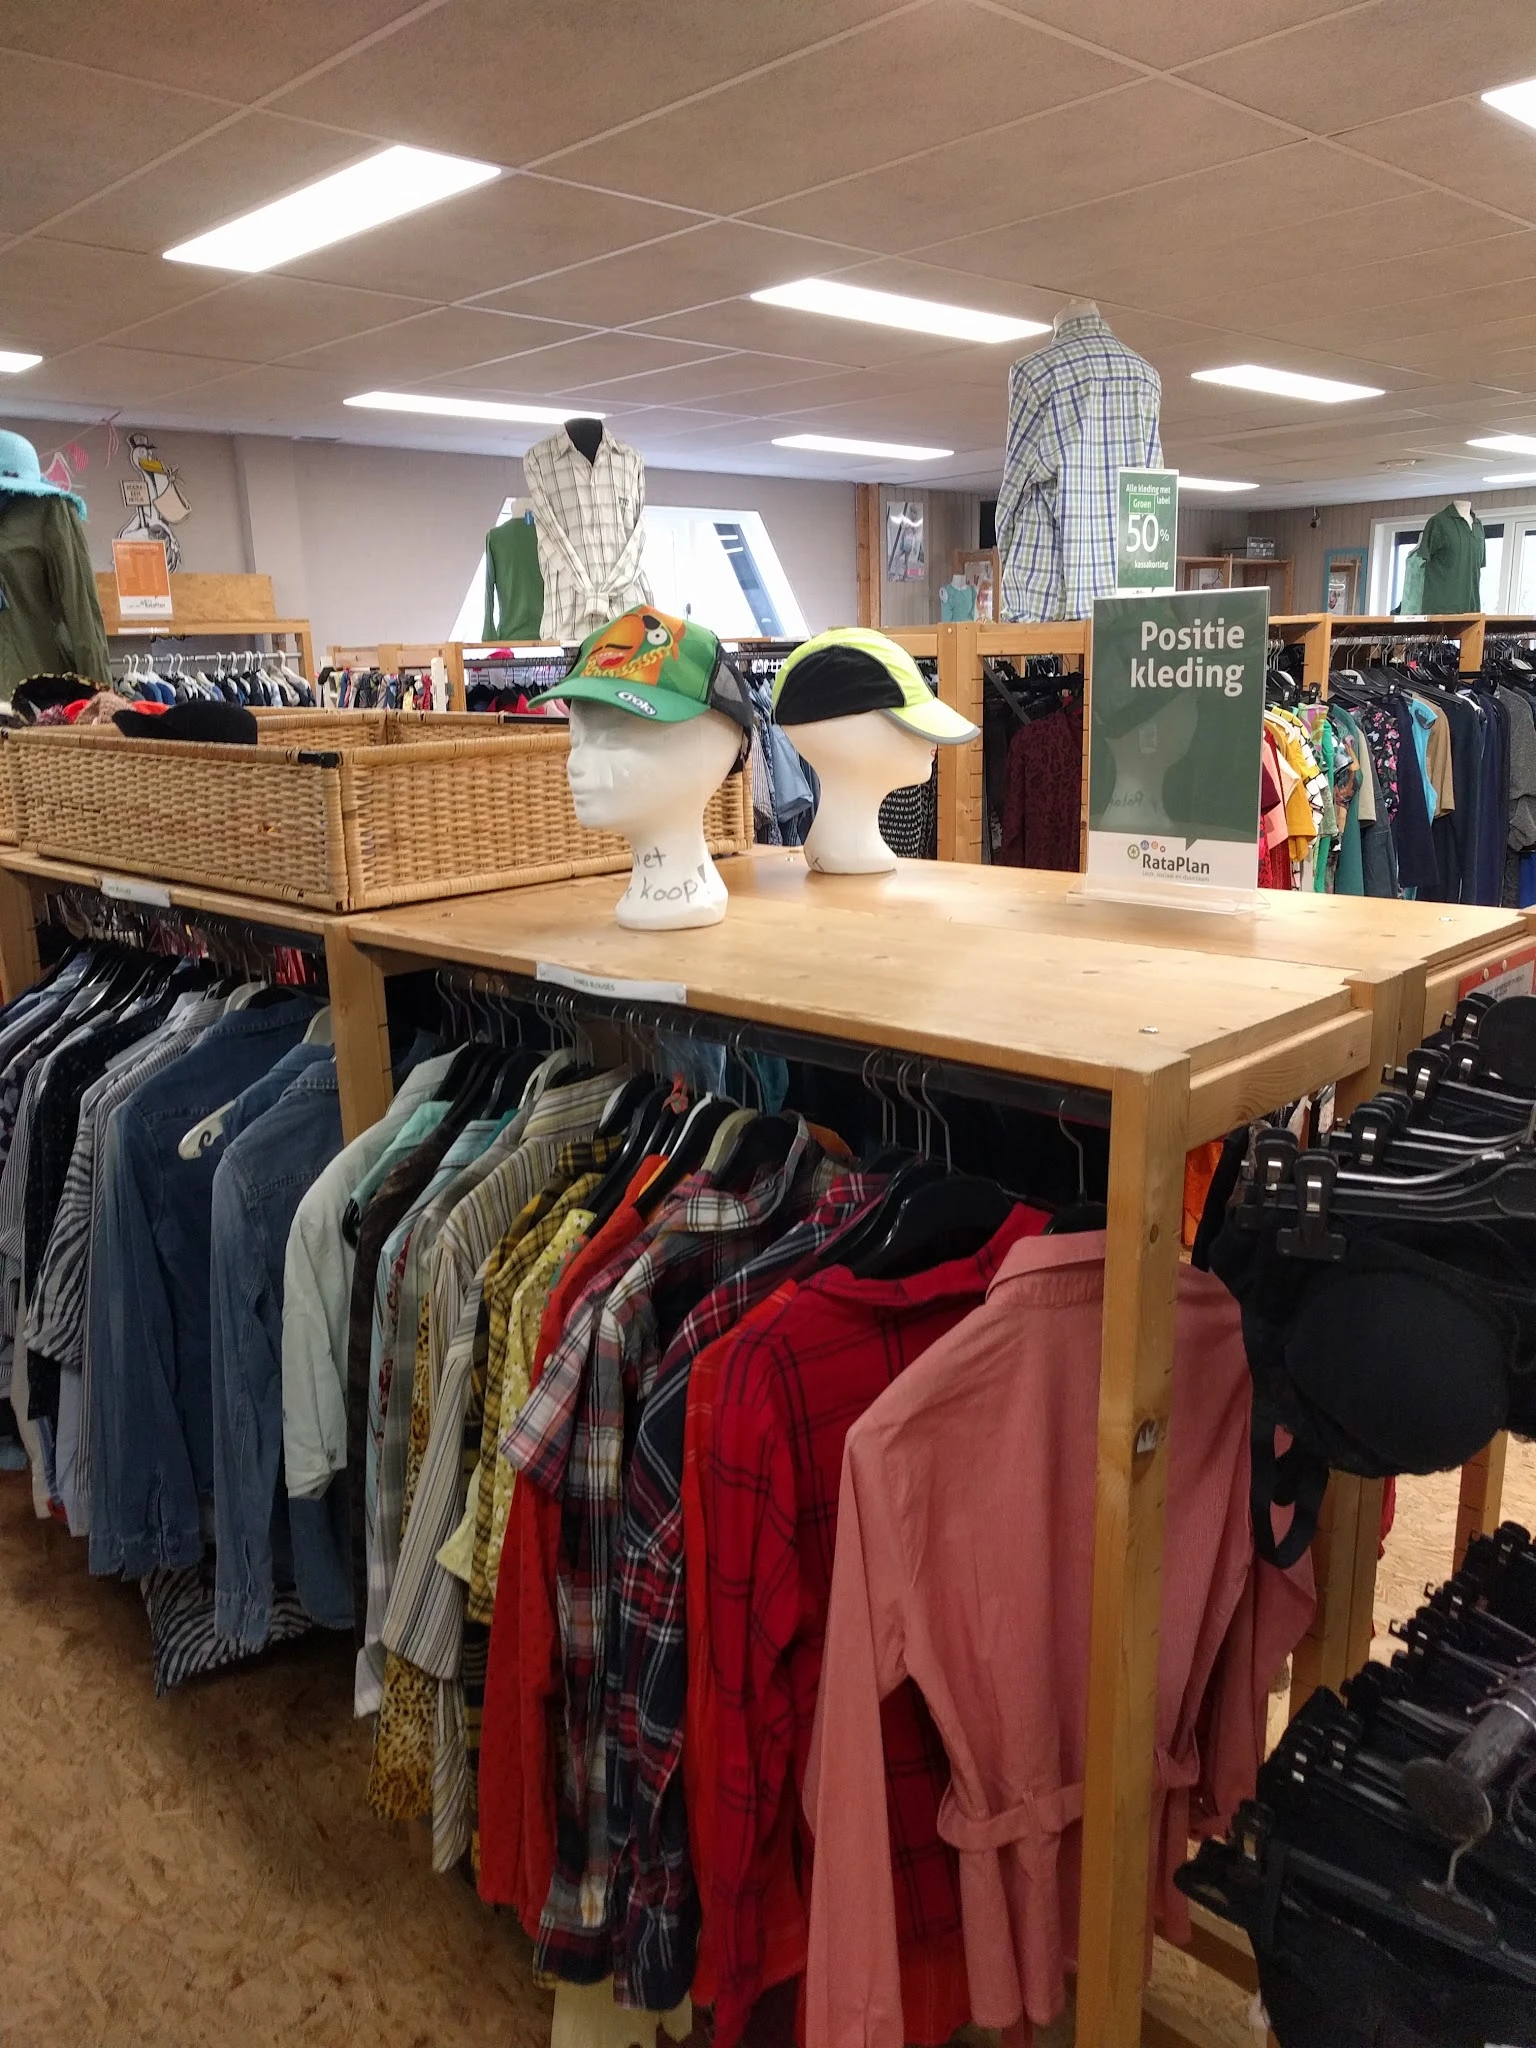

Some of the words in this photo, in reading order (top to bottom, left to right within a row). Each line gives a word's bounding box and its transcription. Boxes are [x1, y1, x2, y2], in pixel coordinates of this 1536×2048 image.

[1126, 484, 1137, 492] Alle
[1138, 484, 1159, 495] kleding
[1160, 486, 1171, 494] met
[1133, 498, 1151, 509] Groen
[1156, 496, 1170, 505] label
[1126, 514, 1170, 553] 50%
[1134, 560, 1169, 570] kassakorting
[1141, 617, 1245, 651] Positie
[1130, 657, 1245, 697] kleding
[1142, 854, 1210, 875] RataPlan
[640, 863, 710, 904] koop!
